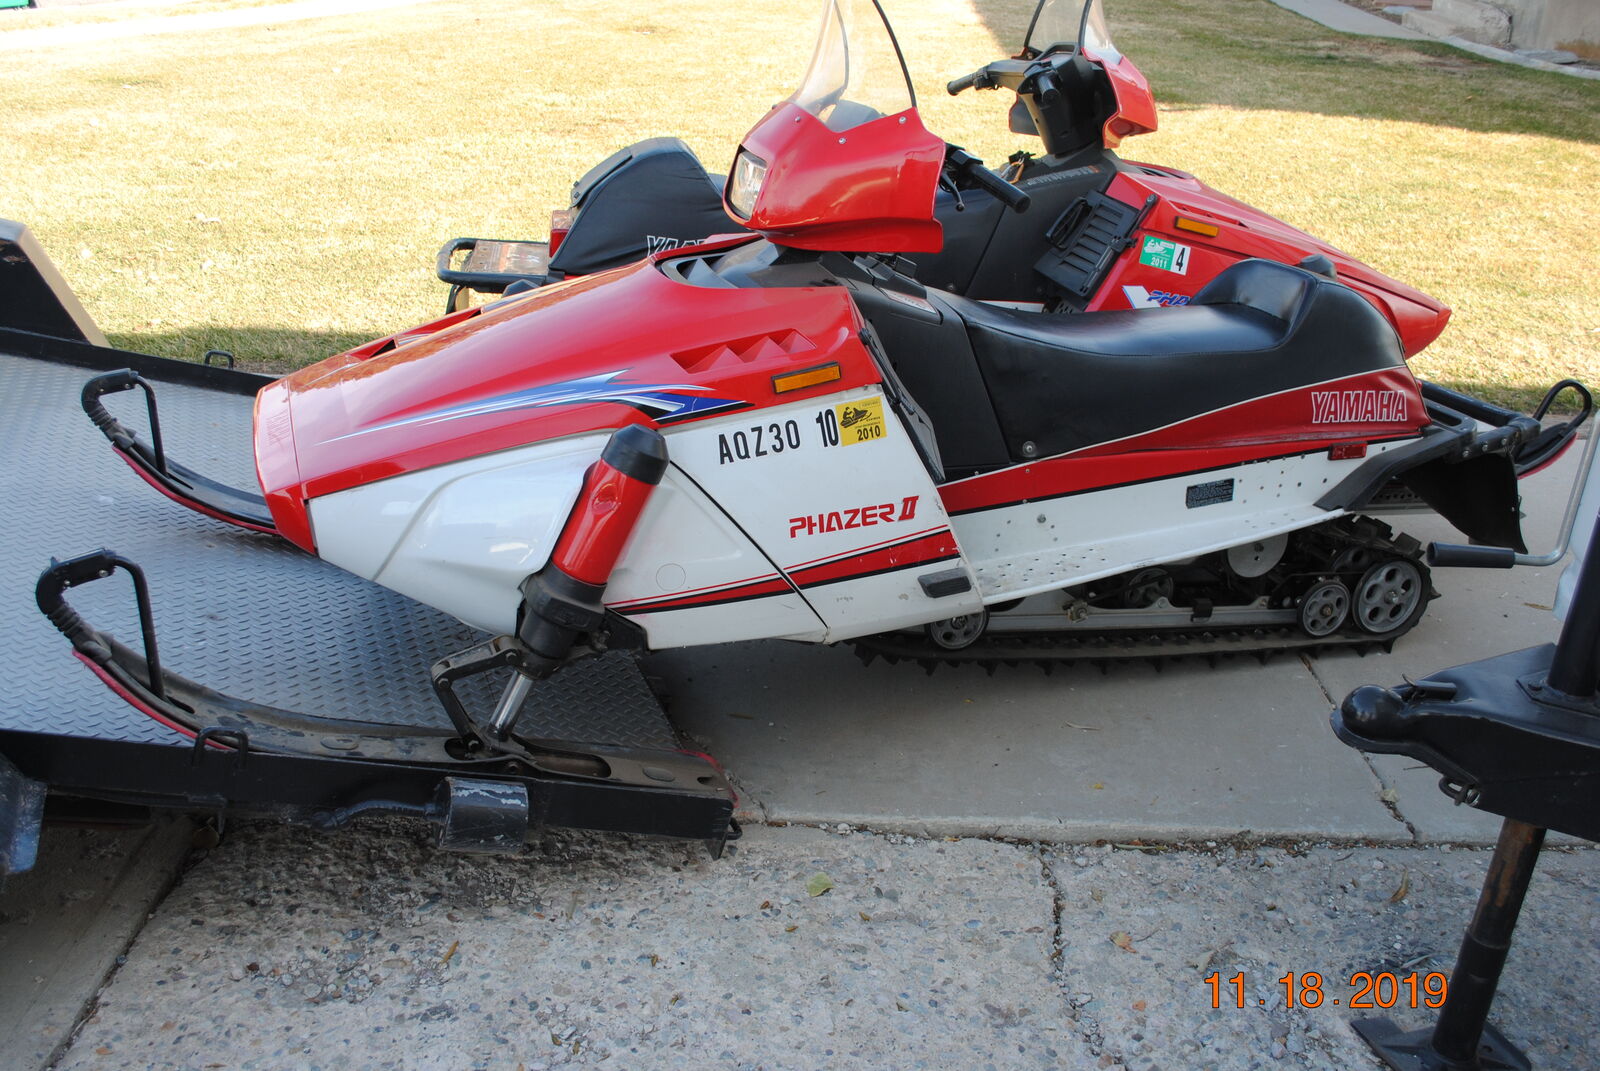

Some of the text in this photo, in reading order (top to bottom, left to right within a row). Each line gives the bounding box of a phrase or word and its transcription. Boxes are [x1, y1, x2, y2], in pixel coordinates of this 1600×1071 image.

[1150, 256, 1167, 269] 2011
[1175, 247, 1186, 271] 4
[1311, 390, 1408, 424] YAMAHA
[718, 408, 839, 465] AQZ30 10
[857, 425, 881, 441] 2010
[789, 495, 920, 538] PHAZER II
